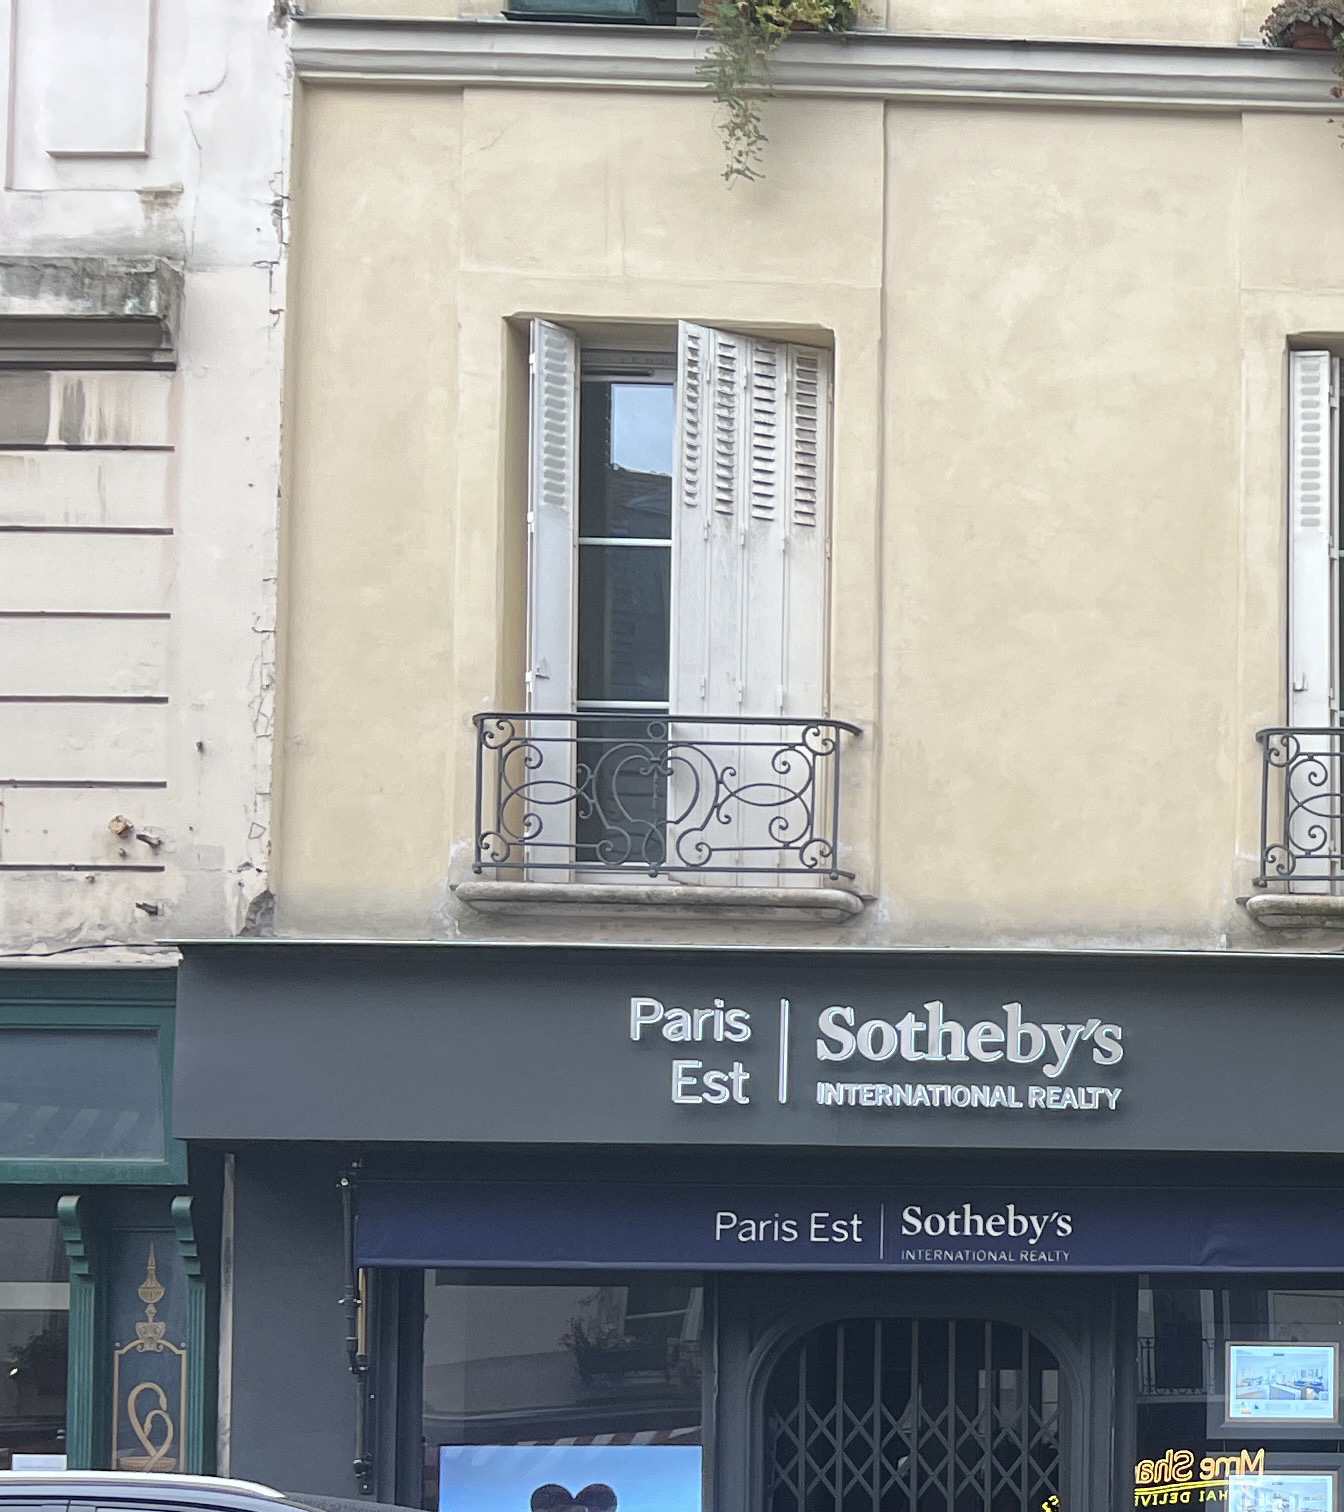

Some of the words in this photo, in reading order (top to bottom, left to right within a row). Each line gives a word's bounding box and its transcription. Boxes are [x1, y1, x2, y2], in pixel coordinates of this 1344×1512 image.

[630, 997, 751, 1043] Paris
[816, 1000, 1124, 1079] Sotheby's
[671, 1059, 751, 1105] Est
[816, 1082, 1024, 1108] INTERNATIONAL
[1027, 1086, 1123, 1110] REALTY
[715, 1212, 799, 1242] Paris
[810, 1213, 863, 1243] Est
[902, 1204, 1073, 1245] Sotheby's
[901, 1249, 1015, 1263] INTERNATIONAL
[1020, 1250, 1071, 1263] REALTY
